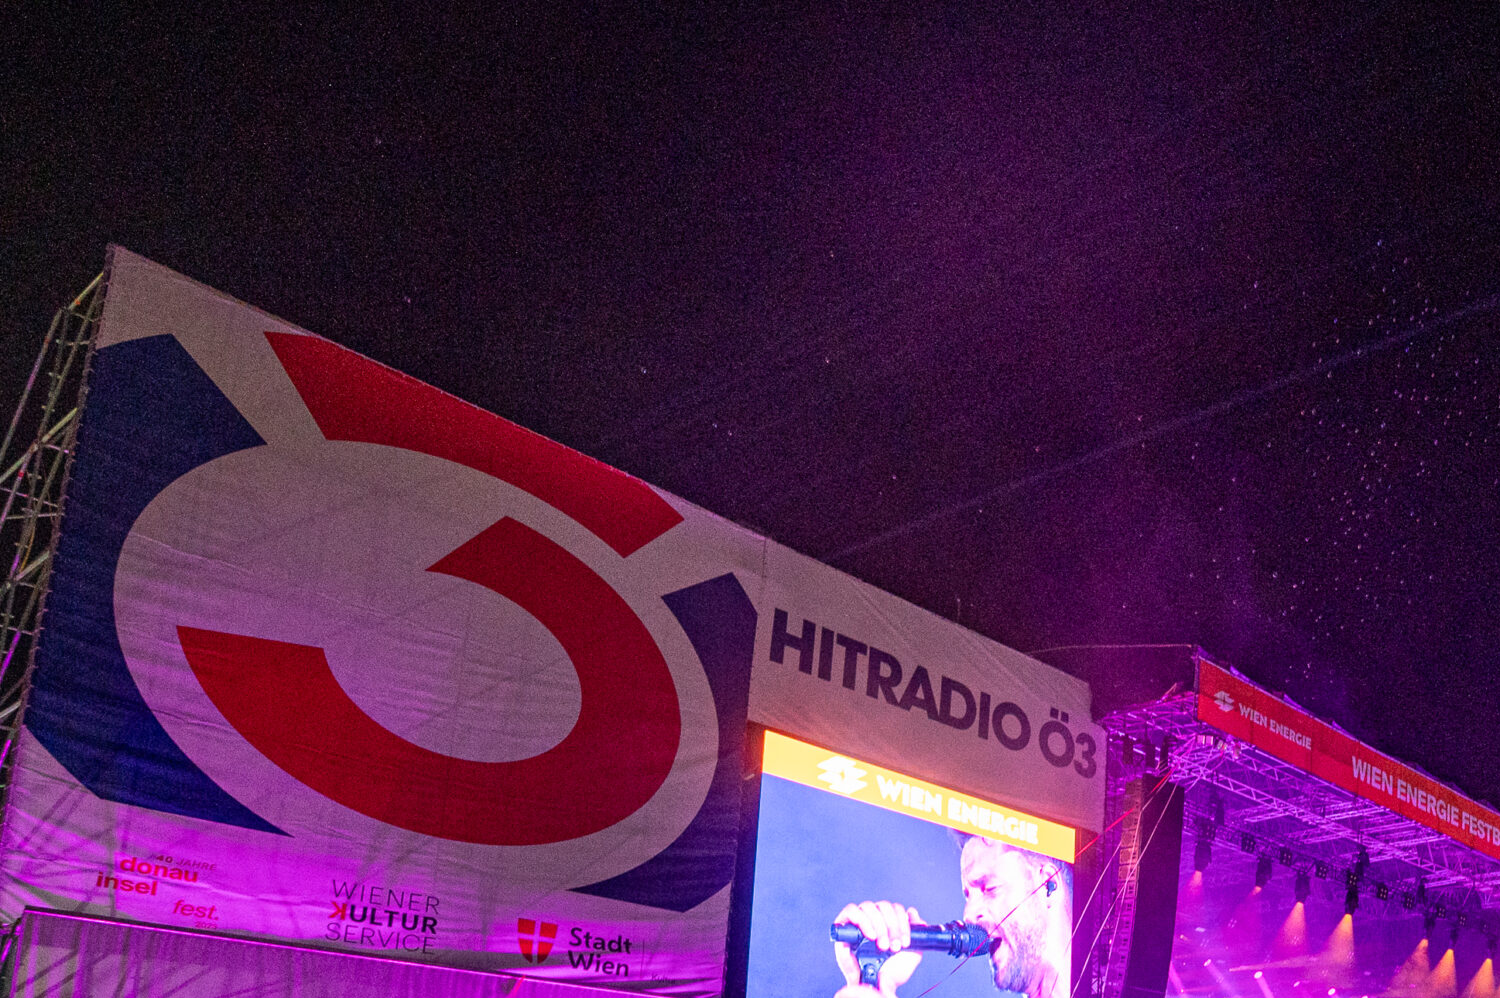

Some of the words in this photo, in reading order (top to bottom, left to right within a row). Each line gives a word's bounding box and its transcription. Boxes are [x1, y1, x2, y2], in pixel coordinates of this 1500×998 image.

[769, 607, 1031, 751] HITRADIO
[1039, 708, 1097, 779] Ö3
[1238, 702, 1268, 728] WIEN
[1269, 718, 1312, 750] ENERGIE
[1352, 755, 1394, 796] WIEN
[1396, 778, 1460, 827] ENERGIE
[876, 774, 942, 817] WIEN
[948, 796, 1039, 845] ENERGIE
[96, 872, 158, 896] insel
[120, 857, 198, 883] donau
[172, 899, 219, 920] fest.
[332, 880, 440, 915] WIENER
[328, 901, 438, 934] KULTUR
[325, 922, 437, 955] SERVICE
[569, 927, 632, 954] Stadt
[567, 950, 629, 977] Wien
